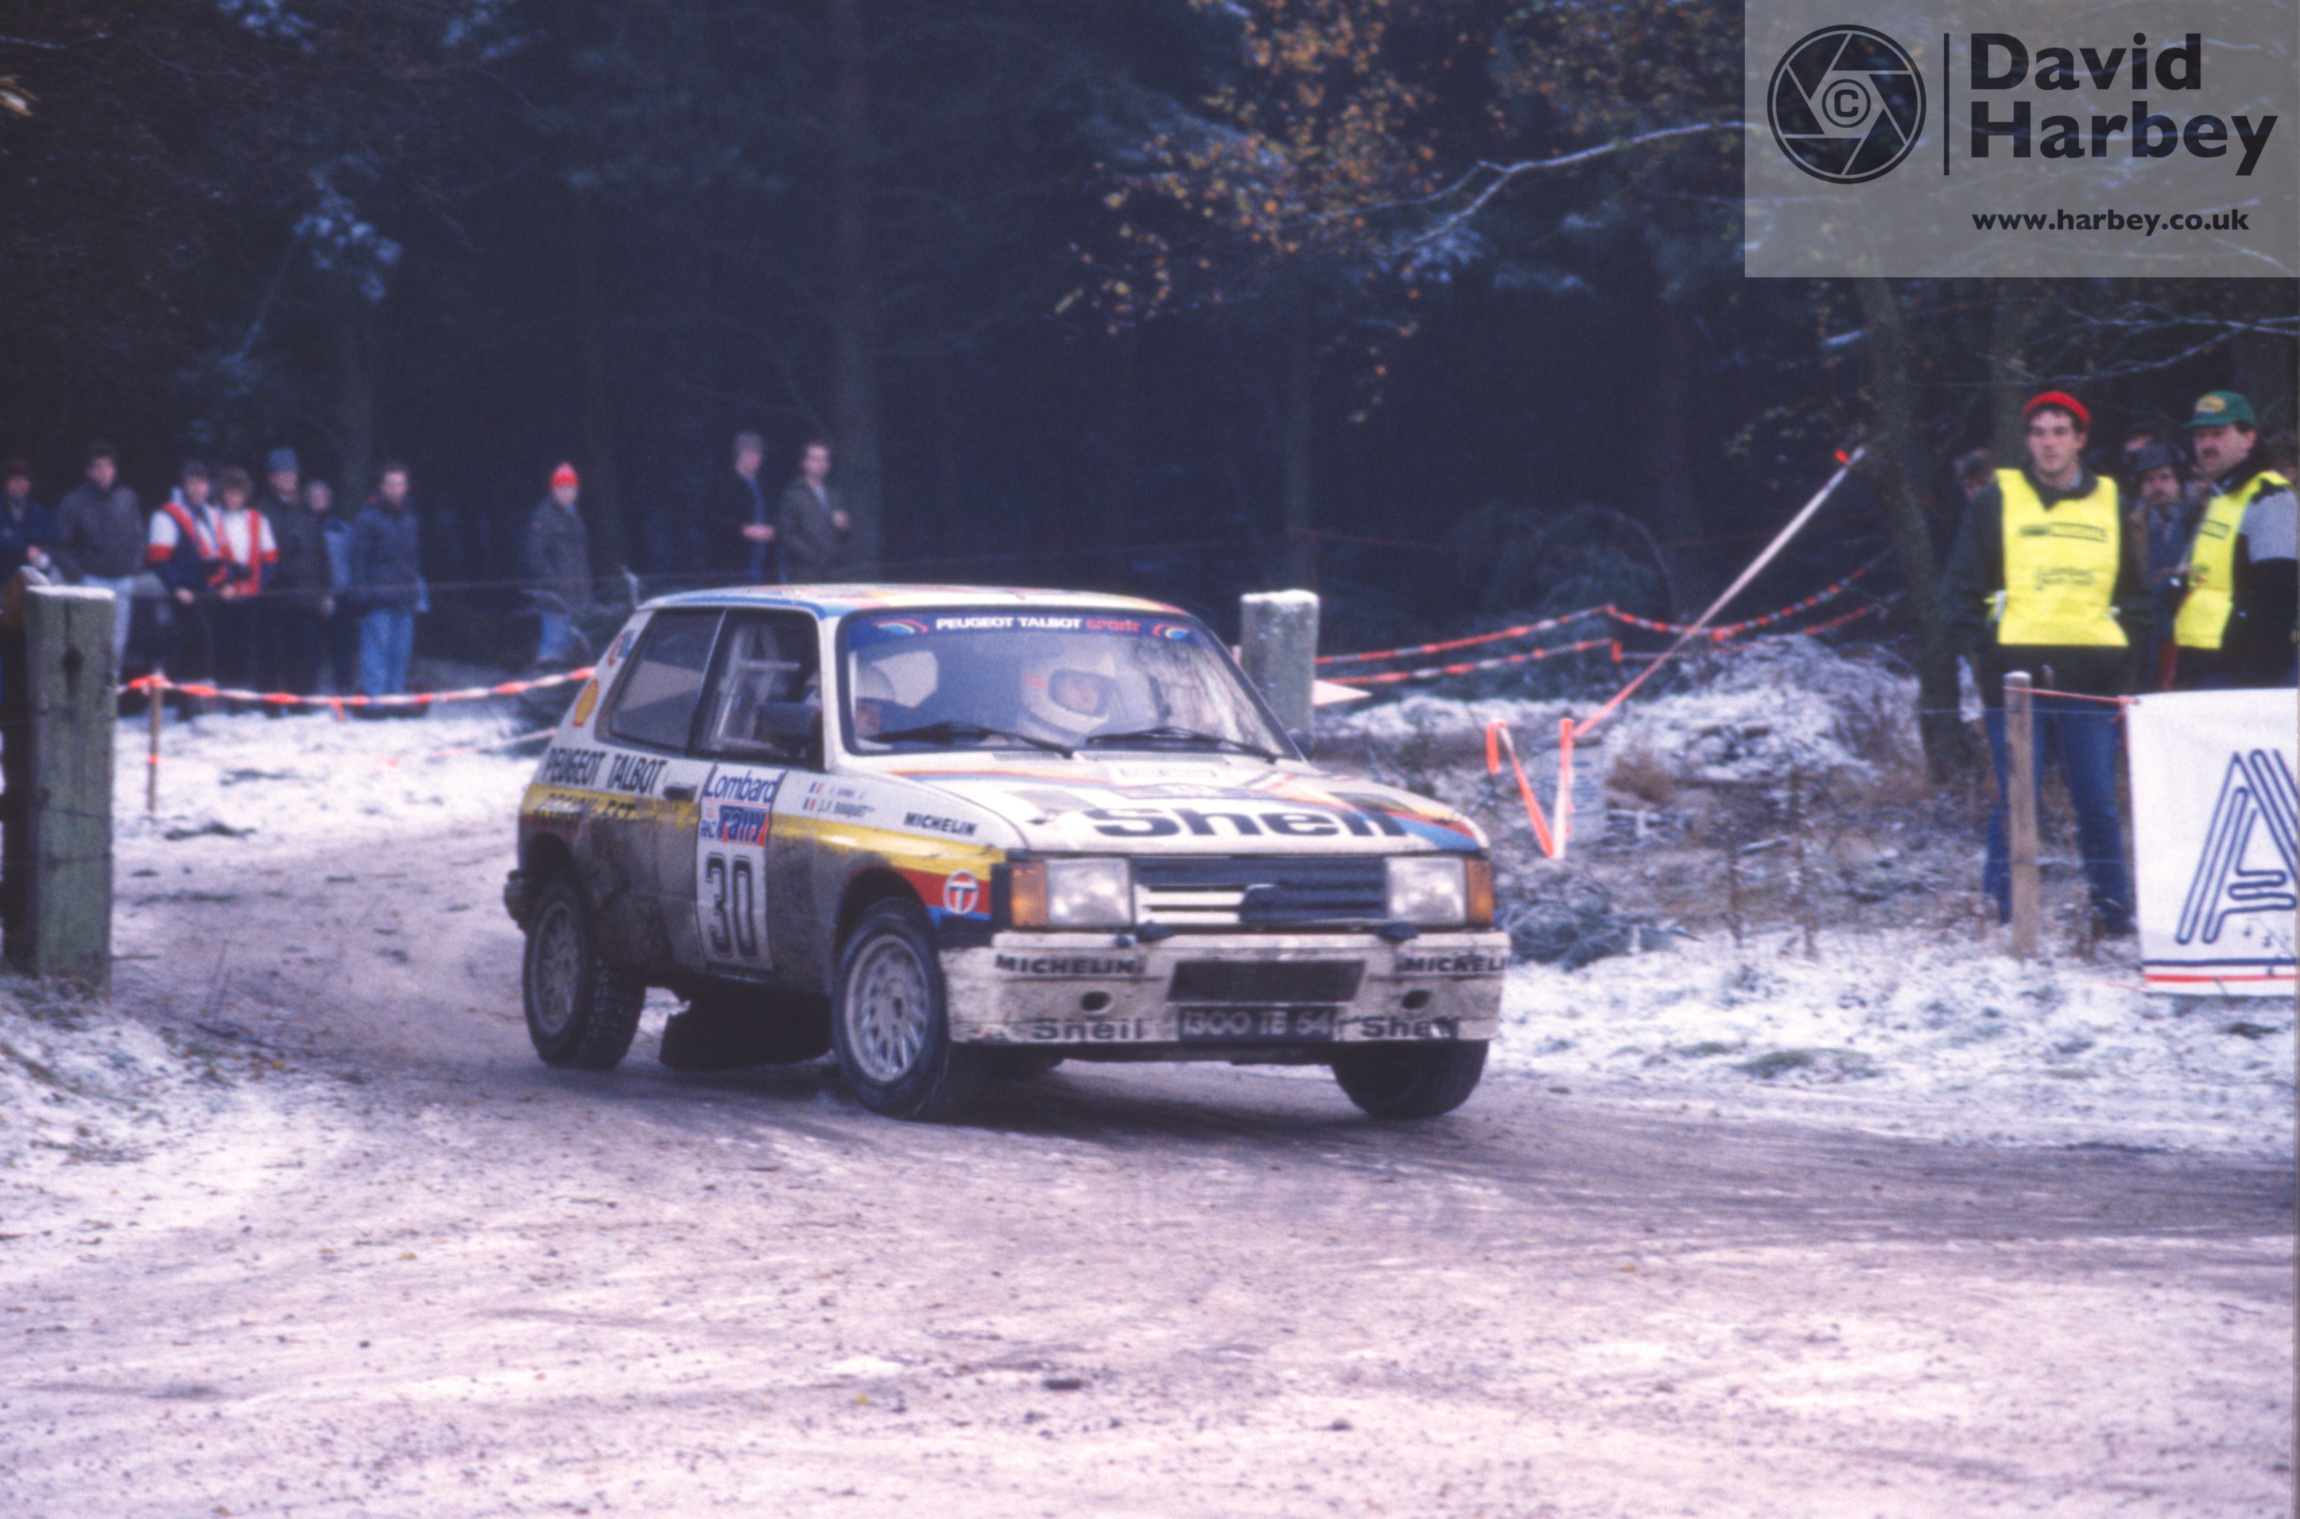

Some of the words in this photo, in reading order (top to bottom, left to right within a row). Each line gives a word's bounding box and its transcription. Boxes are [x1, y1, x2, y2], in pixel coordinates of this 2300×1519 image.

[936, 617, 1013, 630] PEUGEOT
[1017, 616, 1082, 629] TALBOT
[545, 748, 606, 787] PEUGEOT
[606, 754, 667, 795] TALBOT
[703, 765, 784, 803] Lombard
[717, 808, 766, 843] rally
[903, 811, 978, 836] MICHELIN
[1083, 808, 1407, 837] Shell
[705, 852, 758, 958] 30
[995, 954, 1140, 974] MICHELIN
[1030, 1018, 1142, 1040] Shell
